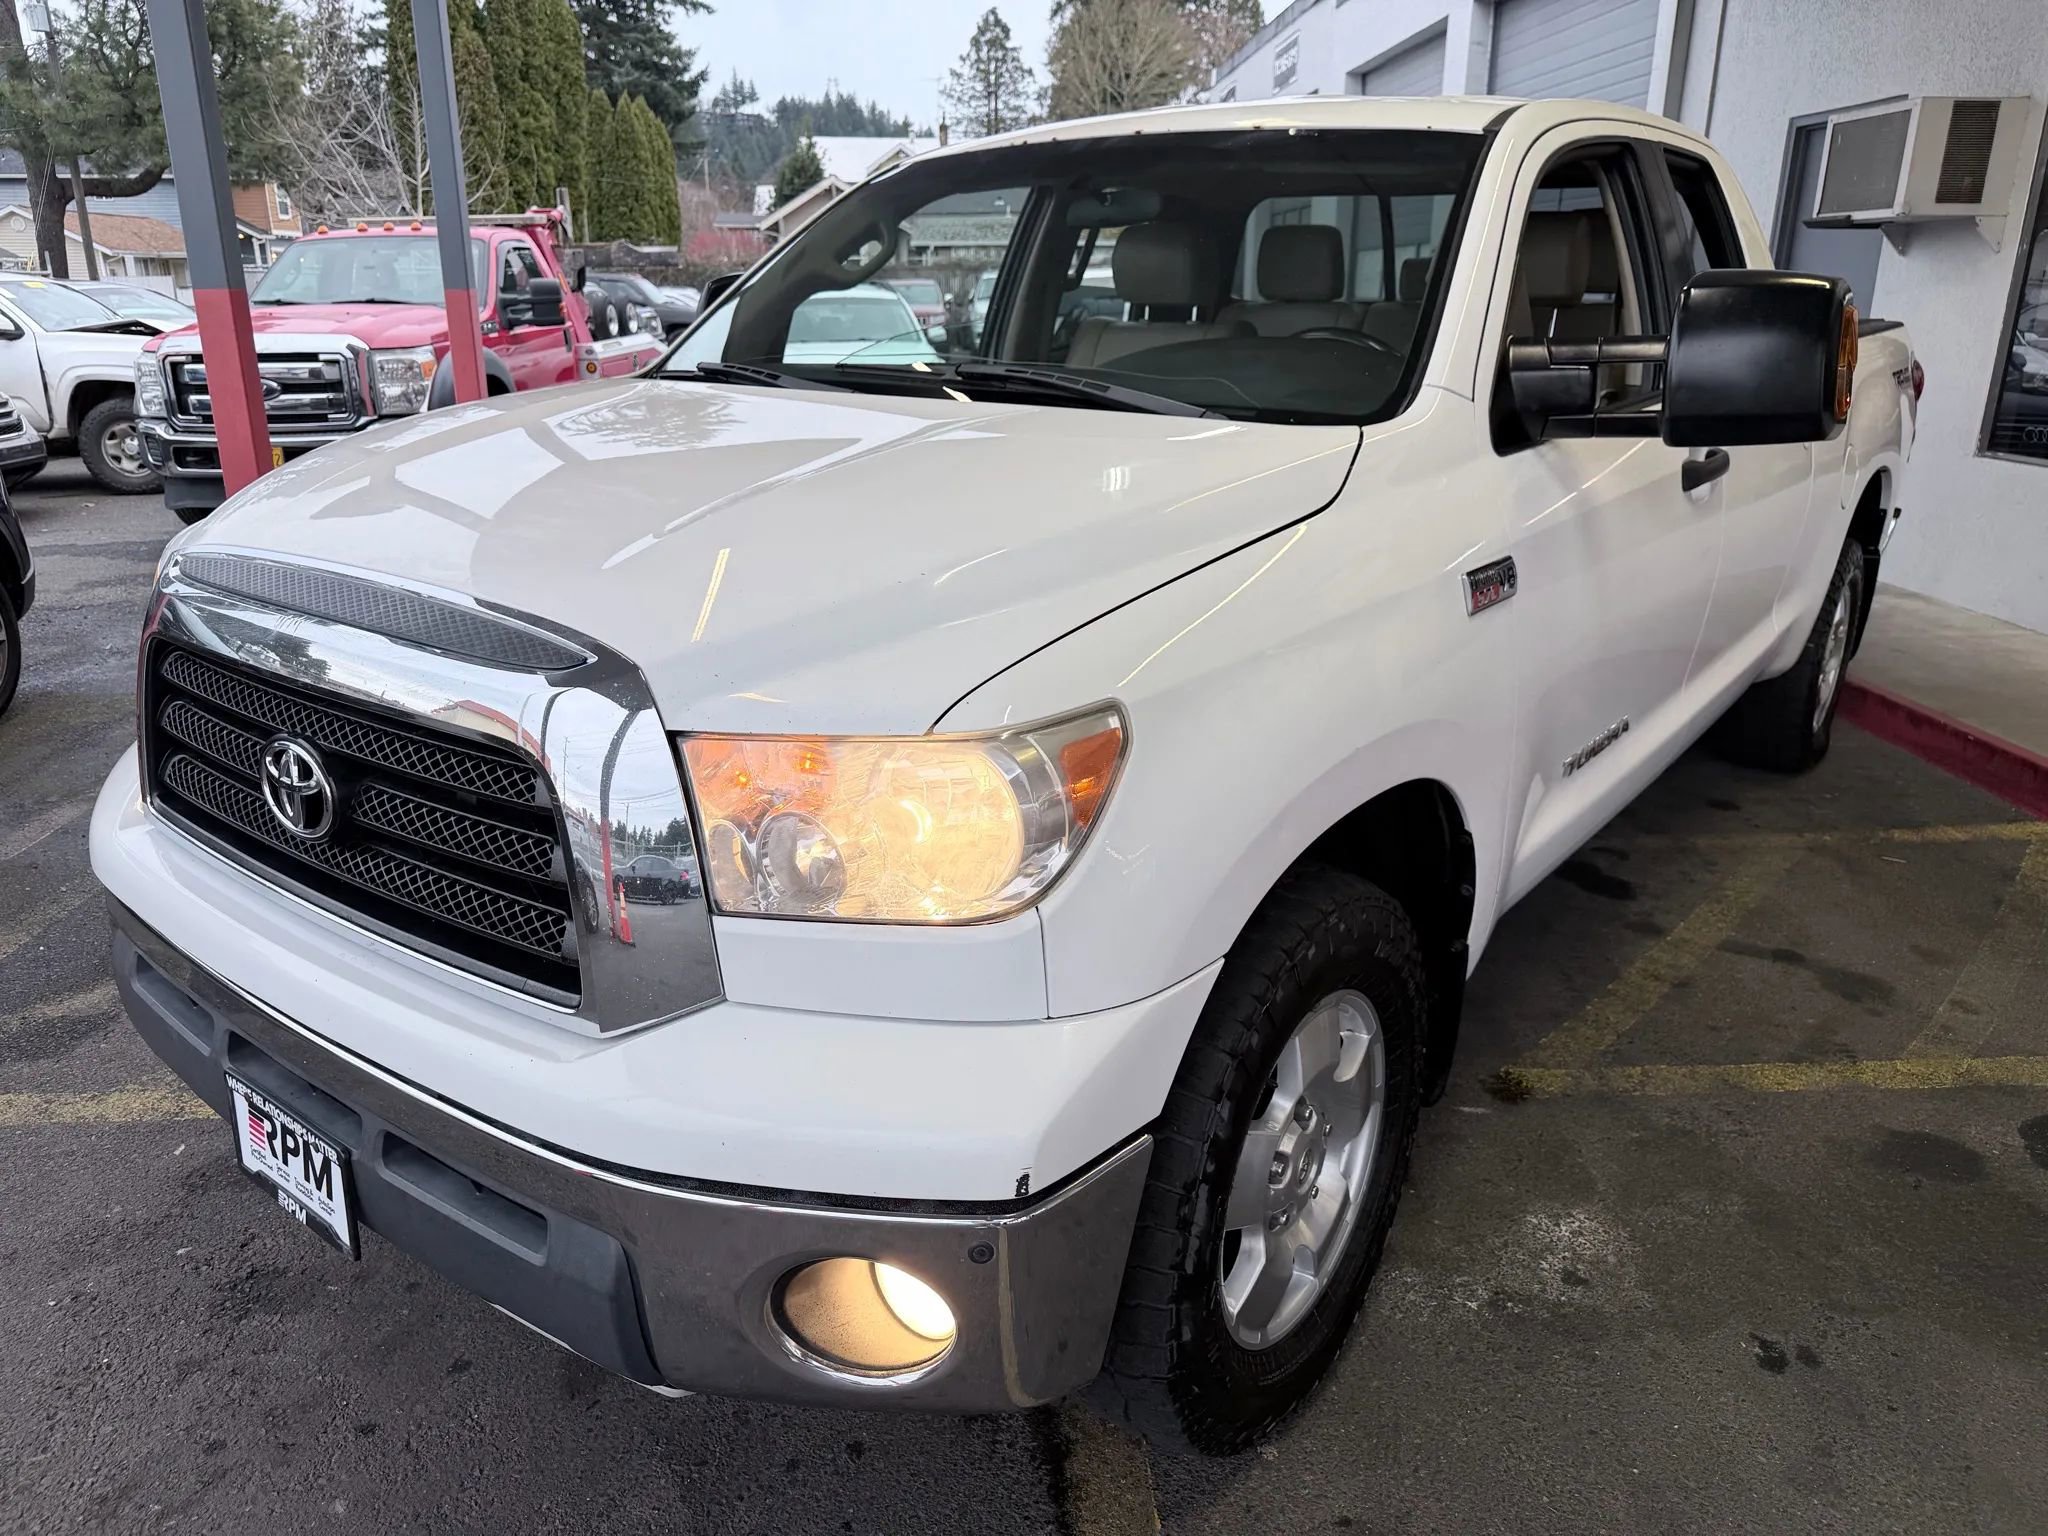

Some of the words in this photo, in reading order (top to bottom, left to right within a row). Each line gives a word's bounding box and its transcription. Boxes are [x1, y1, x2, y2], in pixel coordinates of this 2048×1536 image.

[252, 1092, 308, 1140] RELATIONSHIPS
[248, 1096, 334, 1202] RPM
[277, 1188, 307, 1225] RPM
